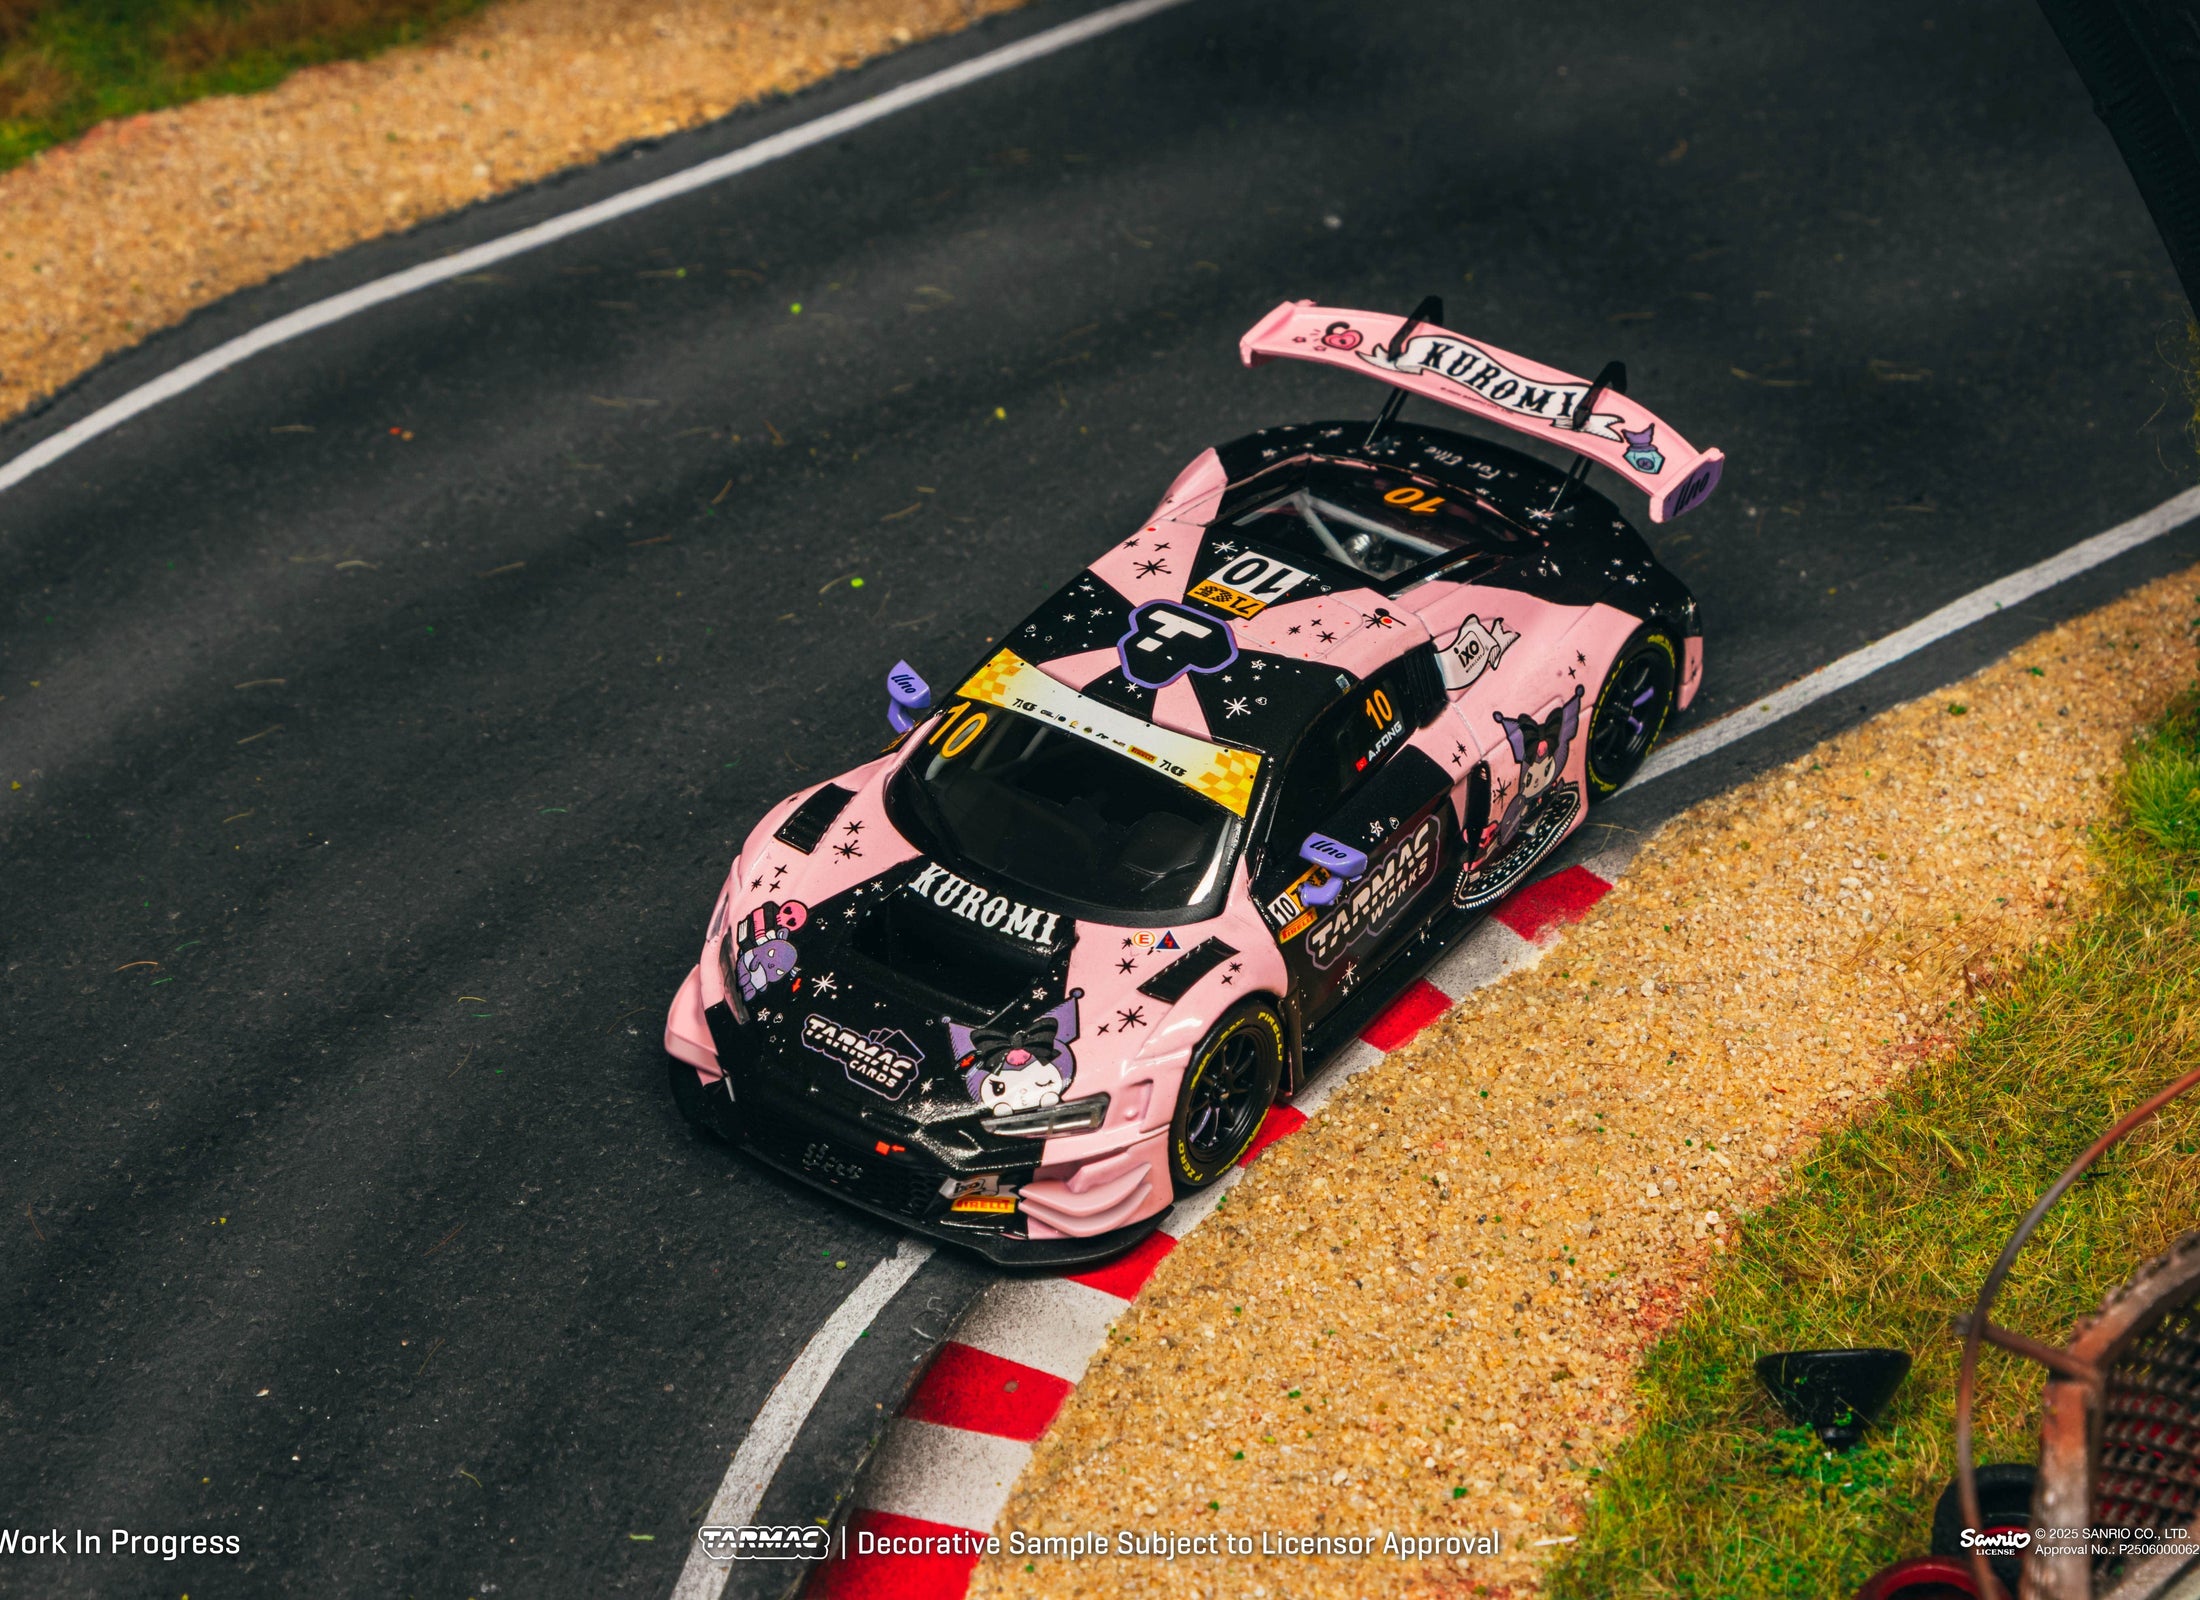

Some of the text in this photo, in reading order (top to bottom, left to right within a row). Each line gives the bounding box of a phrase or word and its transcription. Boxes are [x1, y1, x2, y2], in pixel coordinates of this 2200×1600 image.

[1418, 341, 1577, 417] KUROMI
[1384, 487, 1446, 513] 10
[1221, 557, 1294, 596] 10
[928, 701, 988, 758] 10
[1365, 689, 1393, 731] 10
[1368, 720, 1402, 762] A.FONG
[908, 861, 1061, 945] KUROMI
[1273, 897, 1296, 923] 10
[1312, 823, 1429, 958] TARMAC
[1371, 857, 1428, 924] WORKS
[806, 1018, 912, 1079] TARMAC
[1258, 1012, 1283, 1061] PIRELLI
[849, 1060, 898, 1088] CARDS
